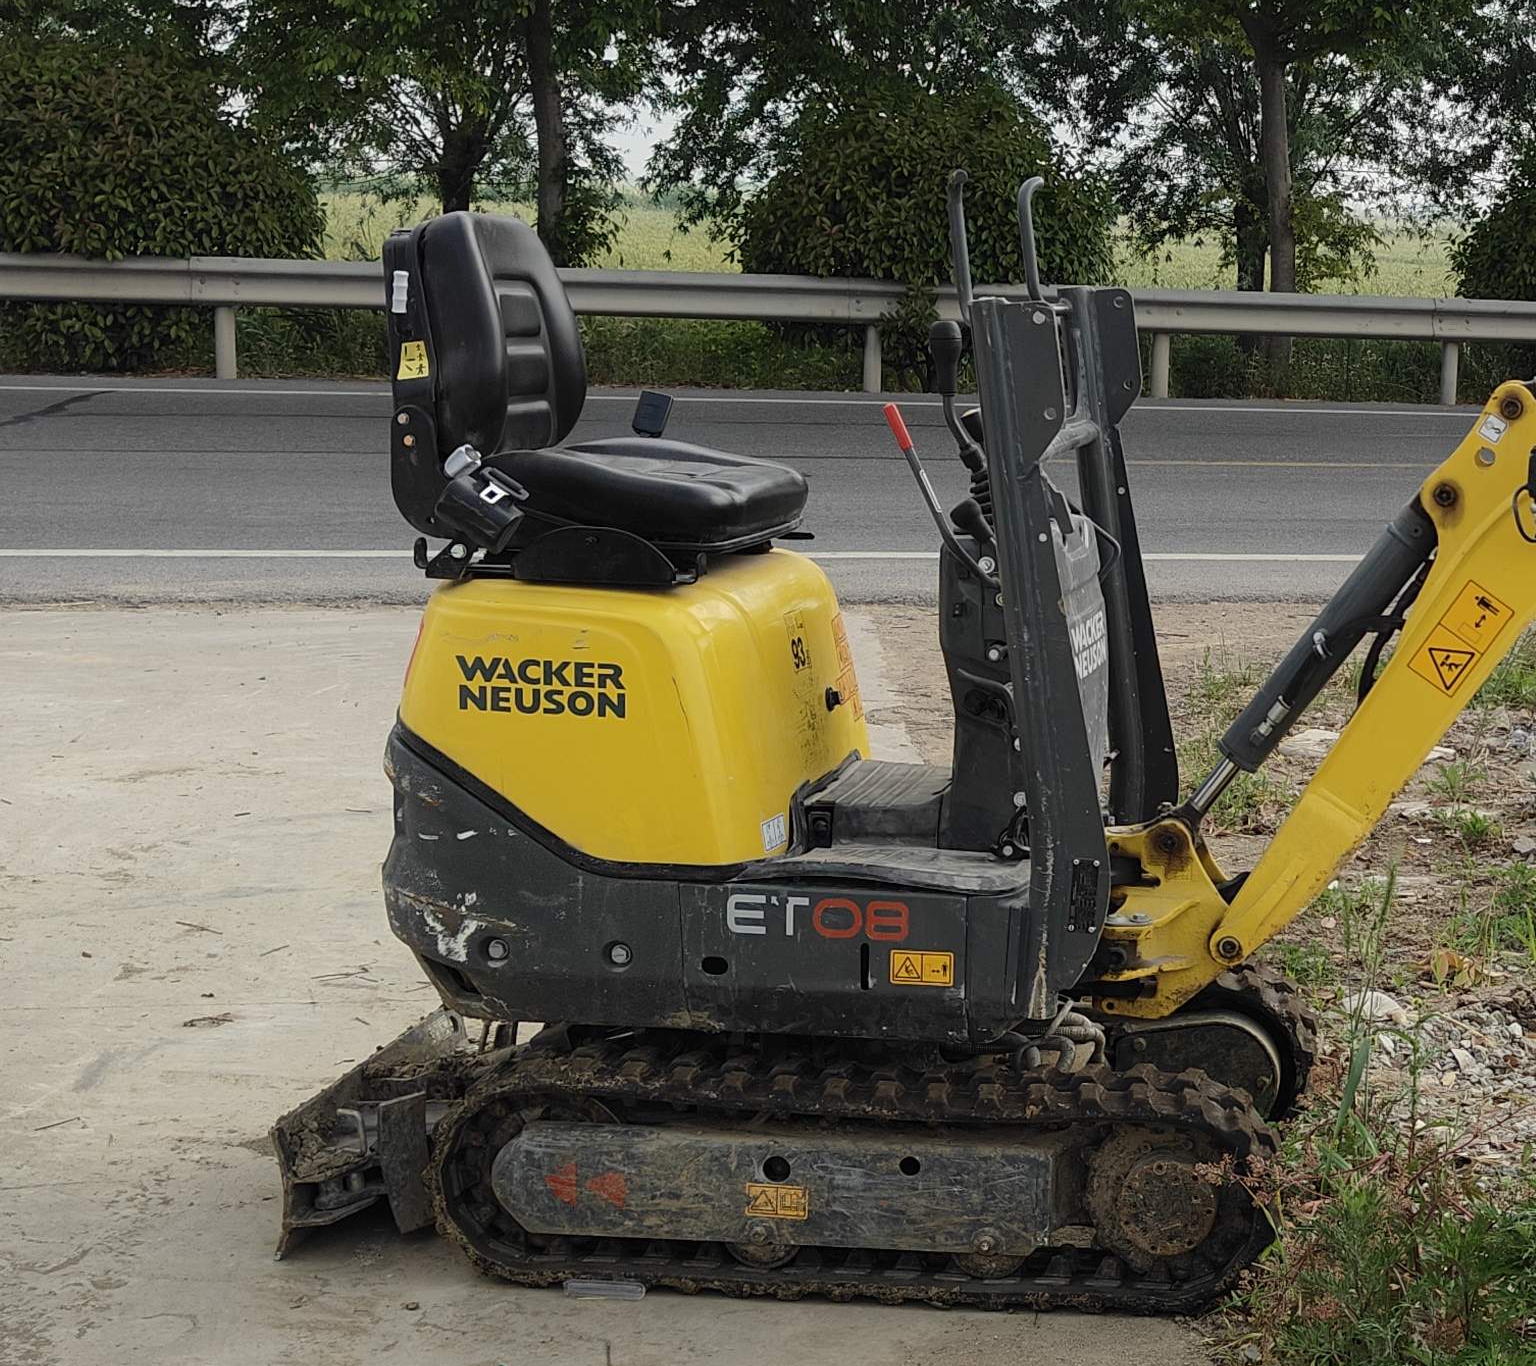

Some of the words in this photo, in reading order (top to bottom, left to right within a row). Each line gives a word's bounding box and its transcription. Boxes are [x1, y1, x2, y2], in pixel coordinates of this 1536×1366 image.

[1071, 610, 1105, 654] WACKER
[791, 636, 806, 669] 93
[1074, 635, 1106, 680] NEUSON
[455, 655, 626, 690] WACKER
[459, 684, 626, 719] NEUSON
[726, 894, 910, 941] ET08
